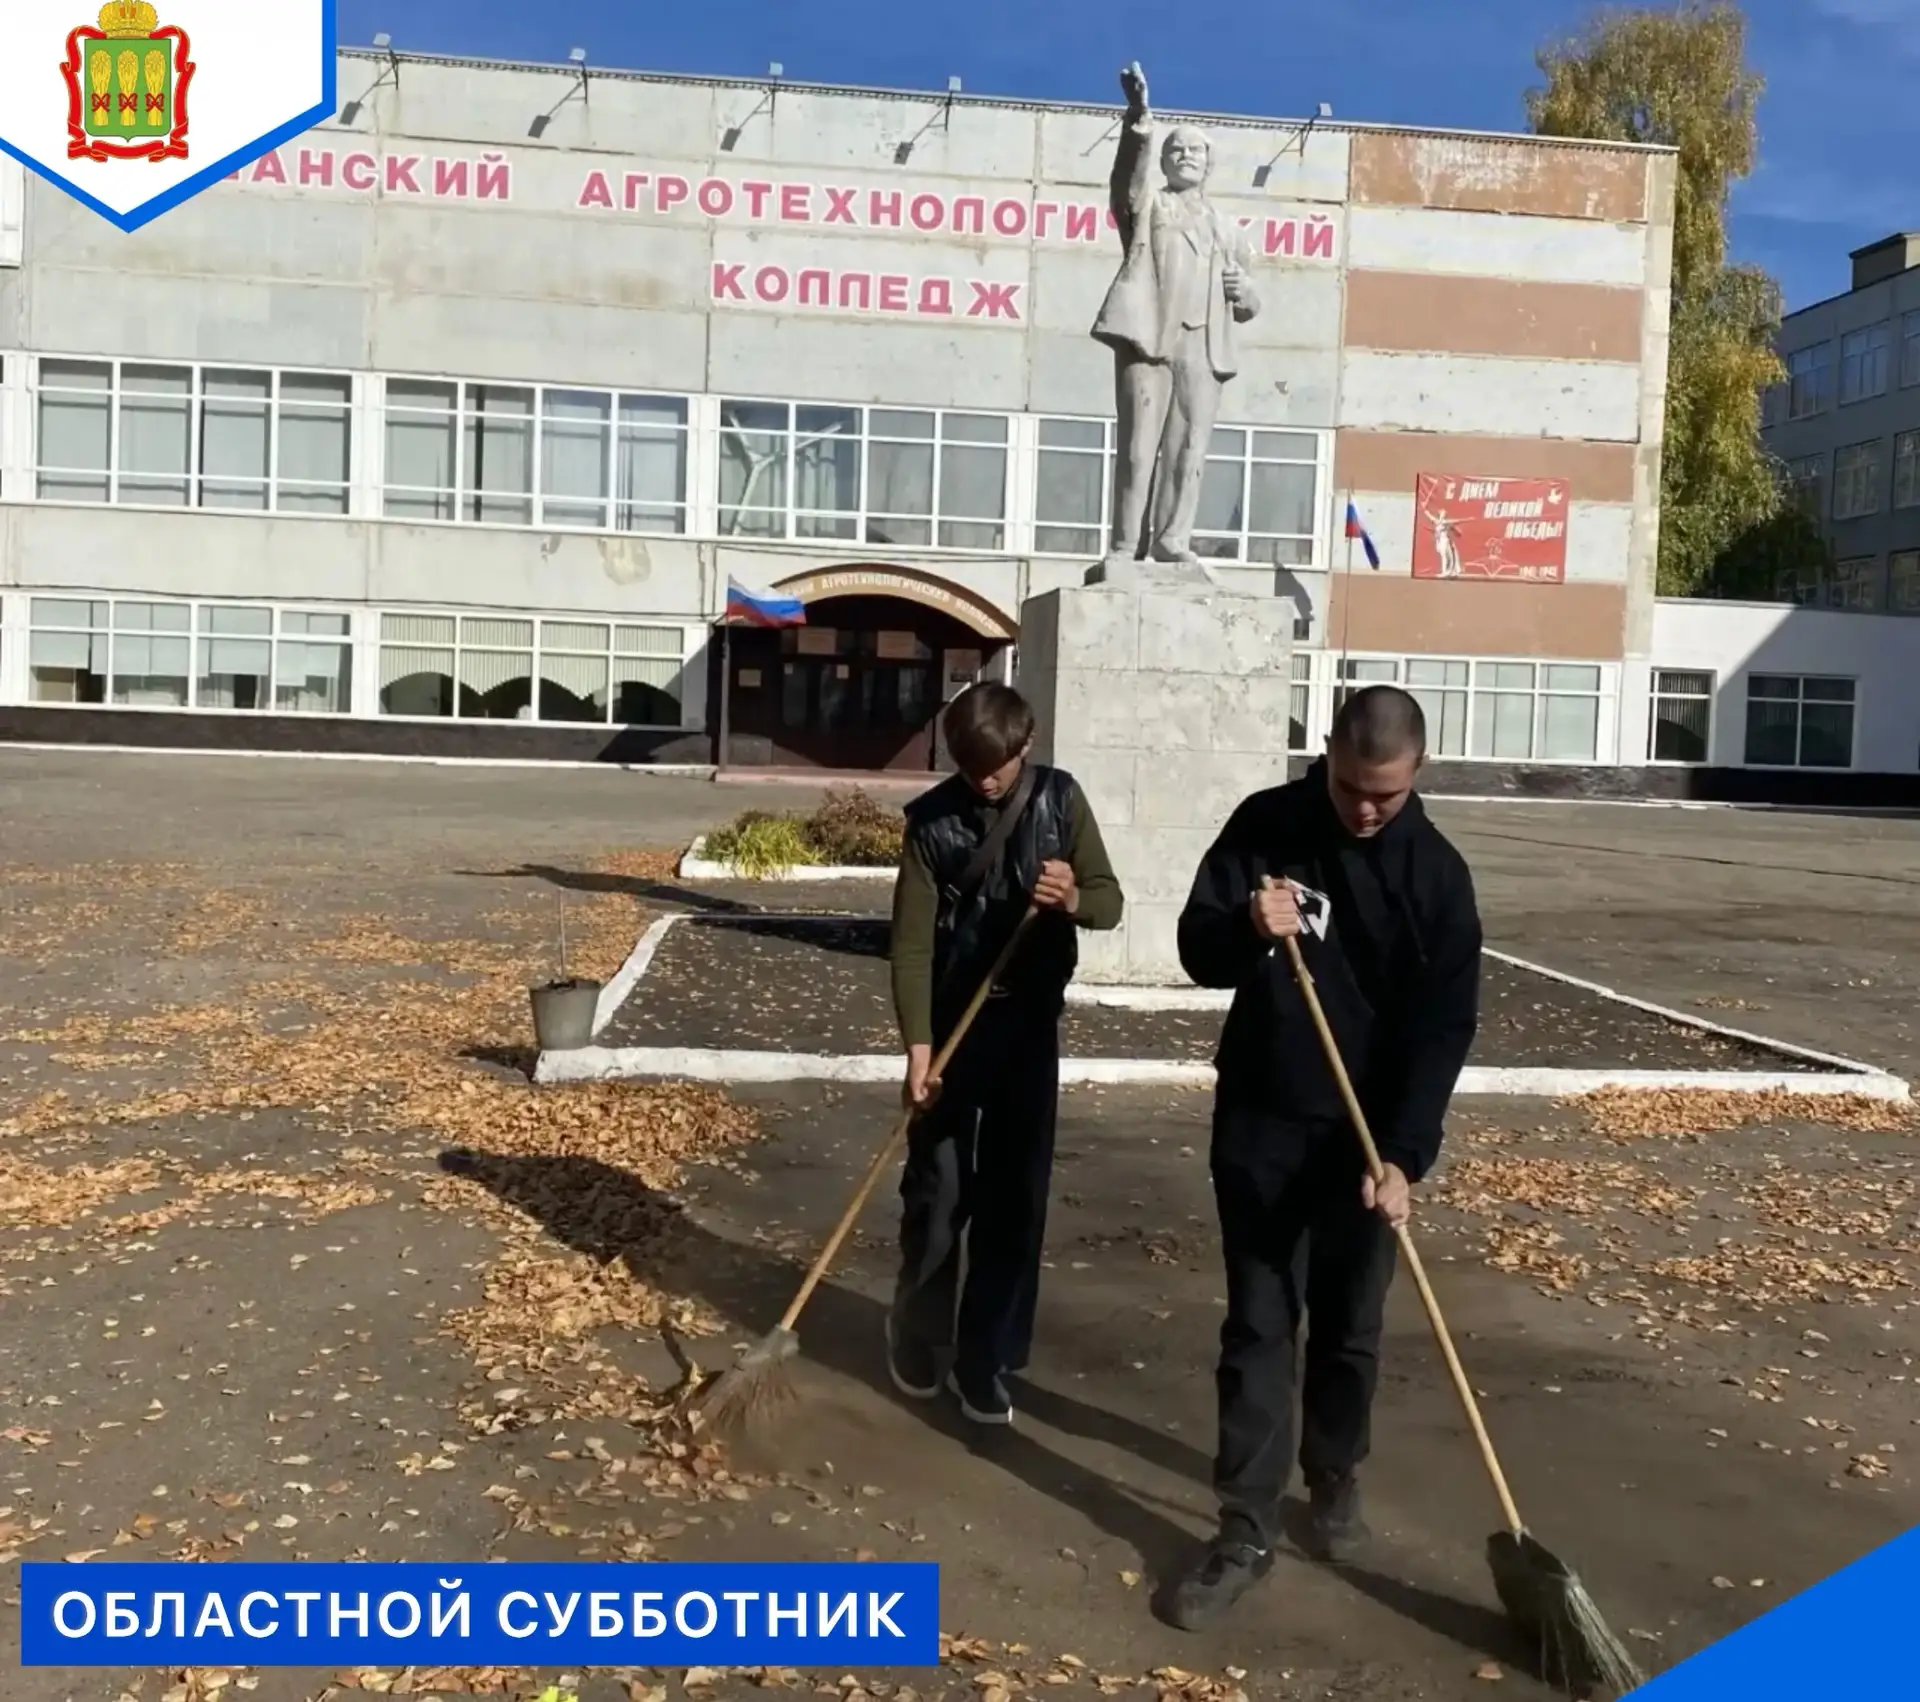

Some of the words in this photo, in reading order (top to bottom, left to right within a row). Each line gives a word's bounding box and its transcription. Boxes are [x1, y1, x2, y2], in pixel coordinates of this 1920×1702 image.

[577, 170, 1336, 259] АГРОТЕХНОЛОГИИЙ
[1445, 482, 1456, 500] С
[1483, 497, 1543, 519] ВЕЛИКОЙ
